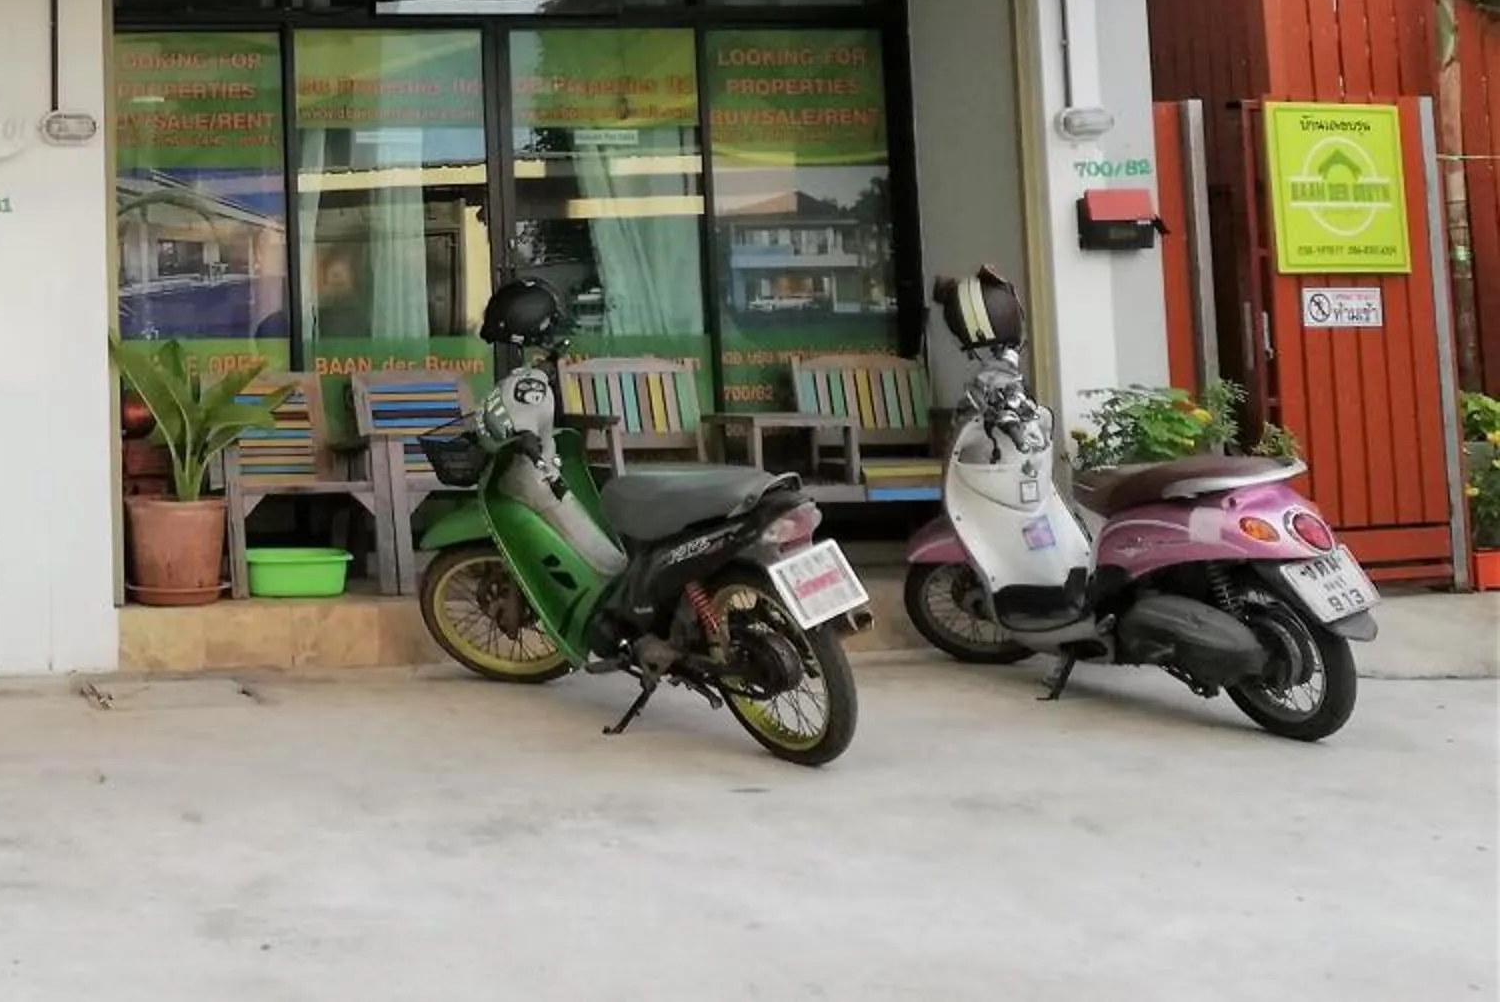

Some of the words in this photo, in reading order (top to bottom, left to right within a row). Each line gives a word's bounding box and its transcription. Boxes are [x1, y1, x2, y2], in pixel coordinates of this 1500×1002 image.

[219, 53, 261, 70] FOR
[717, 49, 812, 68] LOOKING
[824, 49, 866, 68] FOR
[117, 82, 257, 100] PROPERTIES
[726, 79, 860, 97] PROPERTIES
[116, 112, 275, 130] UY/SALE/RENT
[1073, 159, 1152, 177] 700/82
[314, 357, 372, 375] BAAN
[381, 356, 417, 372] der
[424, 356, 485, 375] Bruyn
[1327, 588, 1365, 611] 913
